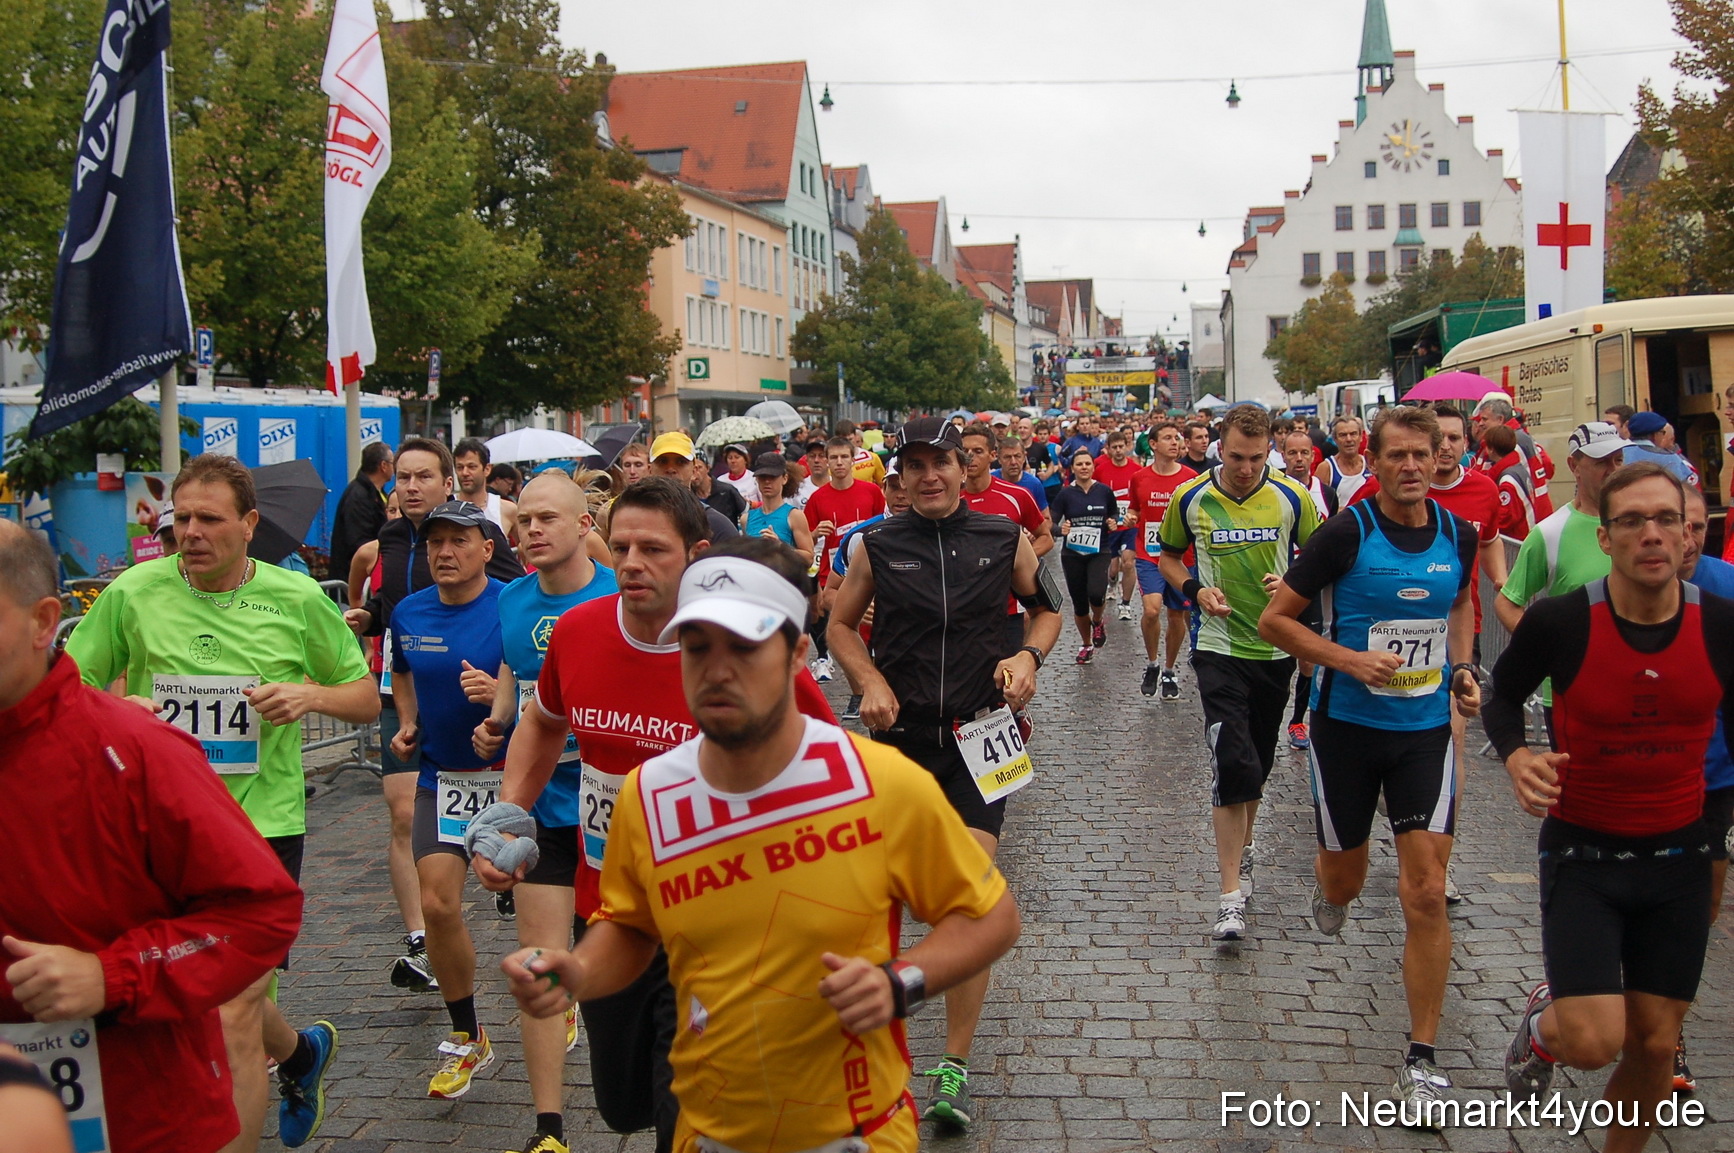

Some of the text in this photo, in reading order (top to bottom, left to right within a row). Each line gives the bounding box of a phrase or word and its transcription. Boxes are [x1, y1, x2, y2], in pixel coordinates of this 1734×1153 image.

[326, 158, 363, 188] ÖGL
[200, 333, 211, 360] P
[690, 360, 706, 377] D
[1519, 355, 1569, 383] Bayerisches
[1094, 374, 1126, 383] START
[1519, 385, 1542, 404] Rotes
[1070, 533, 1098, 546] 3177
[1211, 528, 1278, 543] BOCK
[251, 603, 281, 616] DEKRA
[1370, 627, 1438, 636] PARTL Neumarkt
[1387, 638, 1433, 668] 271
[154, 683, 240, 695] PARTL Neumarkt
[520, 688, 535, 697] PAR
[162, 698, 250, 735] 2114
[572, 706, 693, 742] NEUMARKT
[636, 740, 664, 751] STARKE
[983, 723, 1023, 764] 416
[440, 779, 467, 788] PARTL
[582, 773, 620, 795] PARTL Neu
[658, 816, 882, 909] MAX BÖGL
[13, 1035, 63, 1053] markt
[50, 1056, 85, 1112] 8
